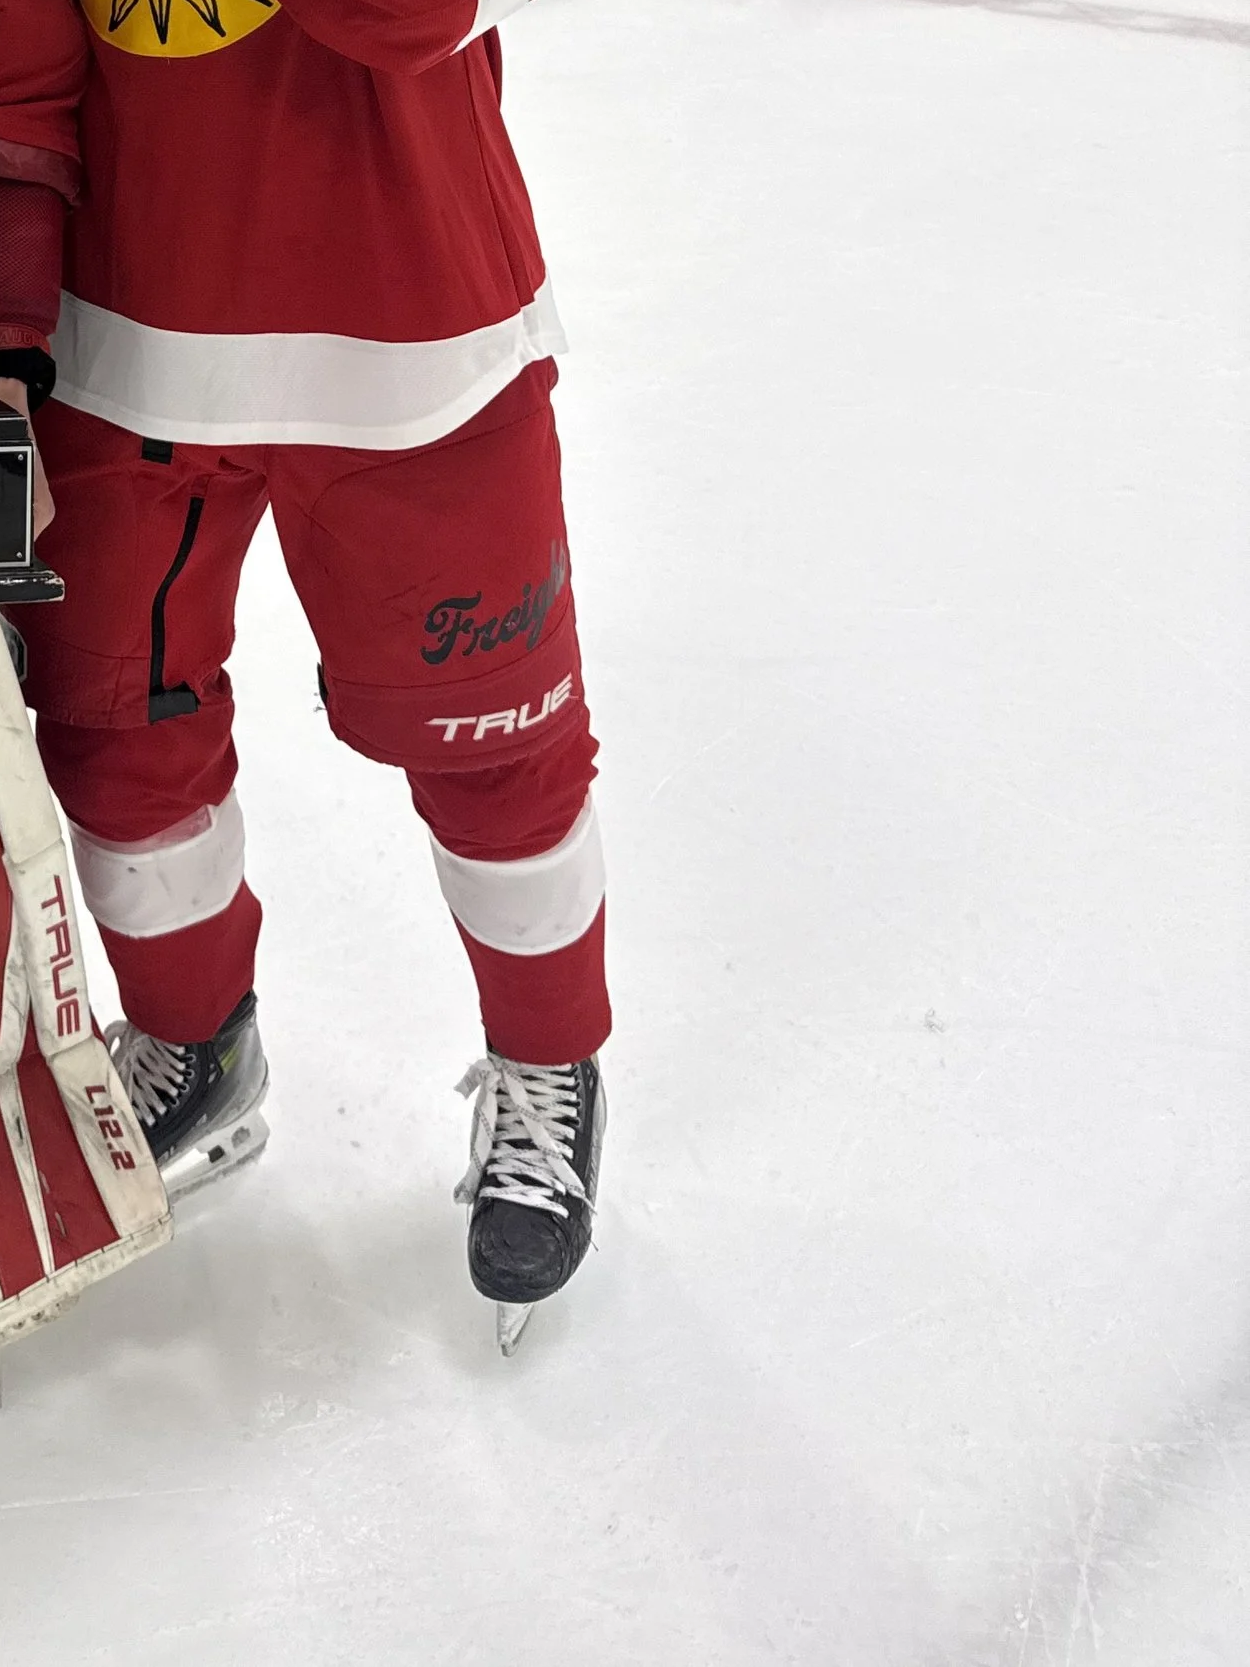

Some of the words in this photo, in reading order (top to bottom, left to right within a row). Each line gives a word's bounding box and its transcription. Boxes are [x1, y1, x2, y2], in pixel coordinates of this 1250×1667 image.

[424, 672, 573, 742] TRUE
[40, 874, 82, 1038] TRUE
[84, 1084, 137, 1172] L12.2
